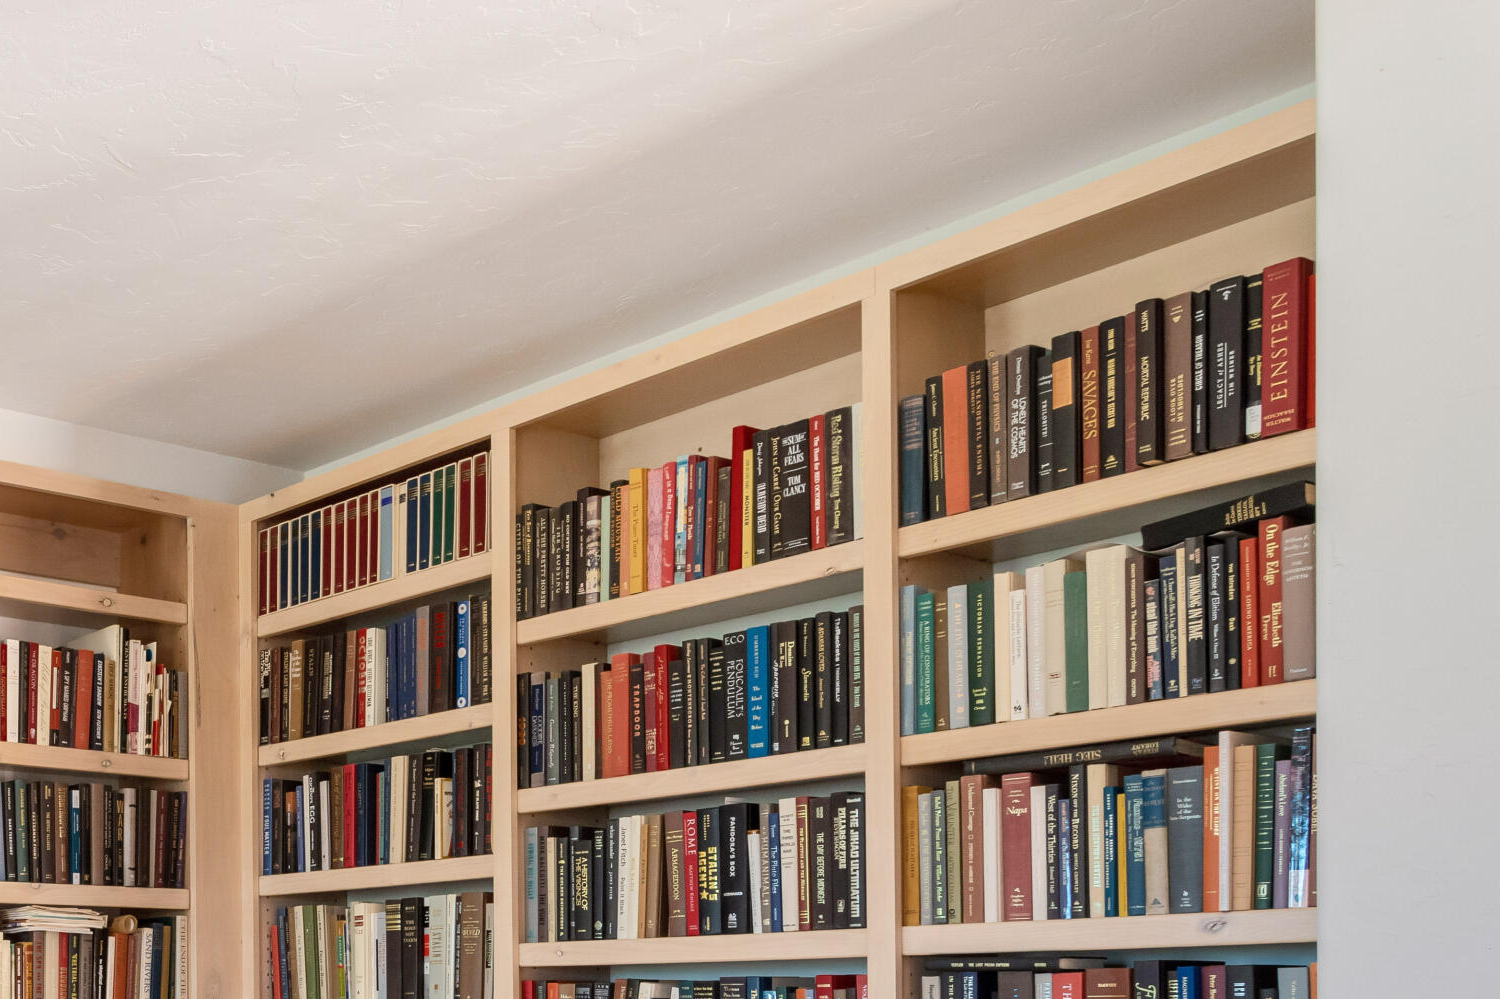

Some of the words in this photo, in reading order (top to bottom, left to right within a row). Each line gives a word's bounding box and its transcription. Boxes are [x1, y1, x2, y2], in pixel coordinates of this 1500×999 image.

[1140, 310, 1149, 332] WATTS
[1216, 342, 1224, 367] ASHES
[1271, 293, 1288, 402] EINSTEIN
[1140, 356, 1150, 387] MORTAL
[1010, 398, 1020, 407] OF
[1083, 369, 1098, 440] SAVAGES
[1140, 388, 1150, 420] REPUBLIC
[1216, 378, 1224, 409] LEGACY
[830, 414, 842, 433] Red
[1010, 408, 1020, 424] THE
[1018, 397, 1027, 426] LONELY
[1265, 415, 1292, 428] WALTER
[771, 436, 781, 456] JOHN
[830, 435, 842, 465] Storm
[1010, 426, 1020, 458] COSMOS
[1018, 427, 1027, 454] HEARTS
[771, 466, 781, 490] CARRÉ
[830, 466, 842, 498] Rising
[771, 494, 781, 512] OUR
[771, 513, 781, 535] GAME
[1266, 524, 1279, 540] On
[1267, 542, 1279, 558] the
[1211, 563, 1220, 589] Defense
[1263, 560, 1279, 586] Edge
[1188, 574, 1203, 608] THINKING
[1188, 608, 1203, 618] IN
[1211, 597, 1220, 621] Elitism
[1188, 618, 1203, 642] TIME
[1261, 614, 1271, 641] Drew
[1271, 601, 1282, 648] Elizabeth
[724, 635, 745, 645] ECO
[727, 661, 735, 719] PENDULUM
[735, 658, 744, 718] FOUCAULT'S
[1071, 774, 1080, 798] NIXON
[849, 808, 859, 827] THE
[686, 818, 696, 855] ROME
[849, 829, 859, 857] JIHAD
[1071, 818, 1080, 850] RECORD
[770, 846, 778, 859] The
[671, 848, 680, 900] ARMAGEDDON
[699, 851, 707, 888] AGENT
[708, 846, 718, 901] STALIN'S
[770, 860, 778, 878] Pluto
[770, 879, 778, 894] Files
[849, 859, 859, 918] ULTIMATUM
[581, 899, 588, 911] OF
[144, 933, 152, 958] SAND
[432, 932, 442, 958] STALIN
[144, 962, 152, 993] RIVERS
[1233, 982, 1246, 997] RED
